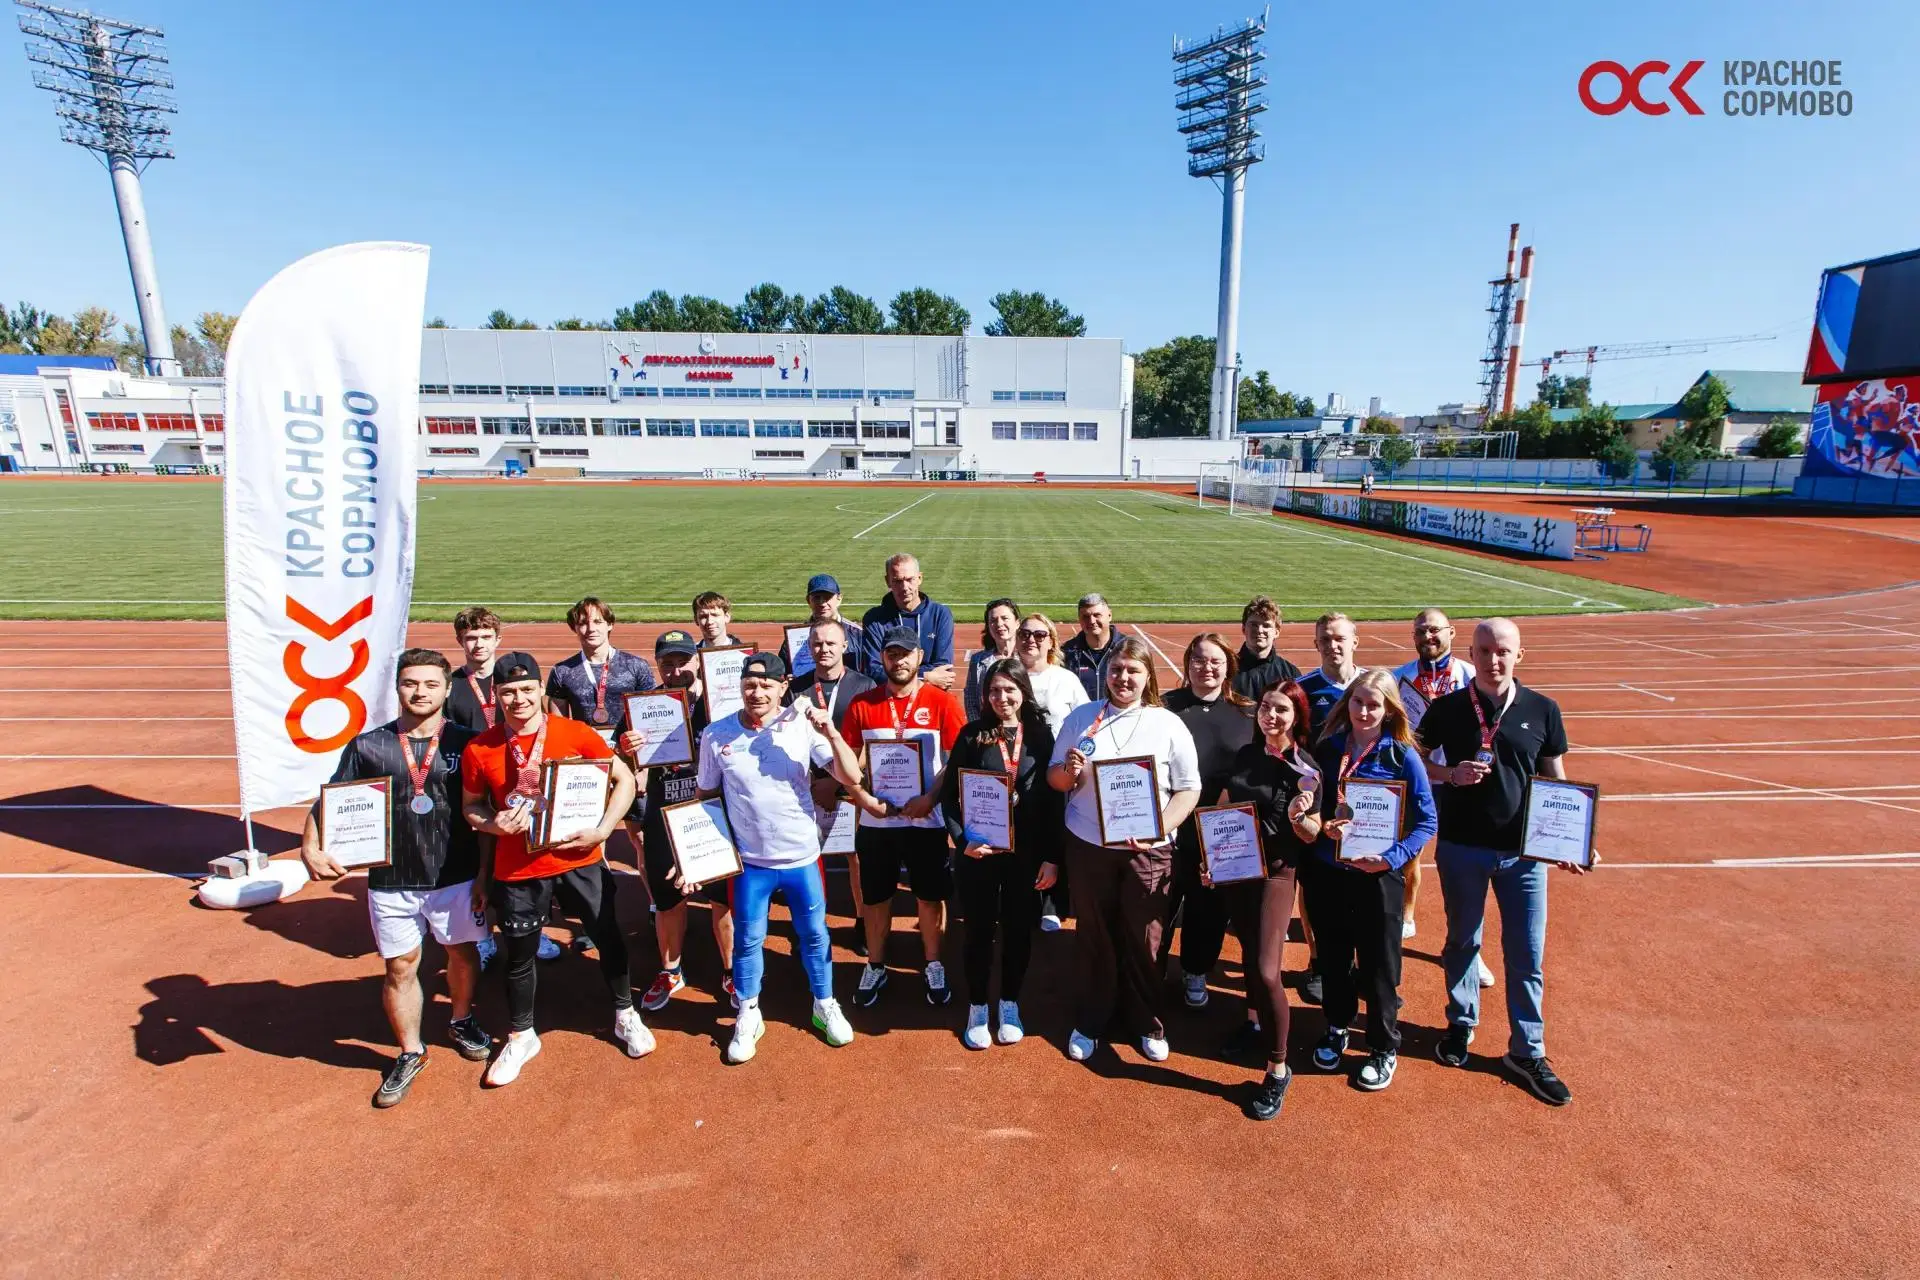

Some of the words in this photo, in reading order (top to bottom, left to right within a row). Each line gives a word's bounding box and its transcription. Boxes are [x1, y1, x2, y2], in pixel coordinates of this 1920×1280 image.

[643, 354, 775, 366] ЛЕГКОАТЛЕТИЧЕСКИЙ
[687, 371, 734, 380] МАНЕЖ
[284, 390, 325, 578] КРАСНОЕ
[341, 390, 379, 578] СОРМОВО
[1504, 520, 1521, 529] ИГРАЙ
[283, 594, 373, 753] ОСК
[641, 710, 674, 719] ДИПЛОМ
[881, 758, 909, 766] ДИПЛОМ
[566, 781, 598, 790] ДИПЛОМ
[1110, 780, 1143, 791] ДИПЛОМ
[971, 790, 1000, 800] ДИПЛОМ
[337, 802, 374, 815] ДИПЛОМ
[1355, 802, 1389, 811] ДИПЛОМ
[1542, 800, 1580, 812] ДИПЛОМ
[823, 811, 849, 819] ДИПЛОМ
[1213, 824, 1246, 836] ДИПЛОМ
